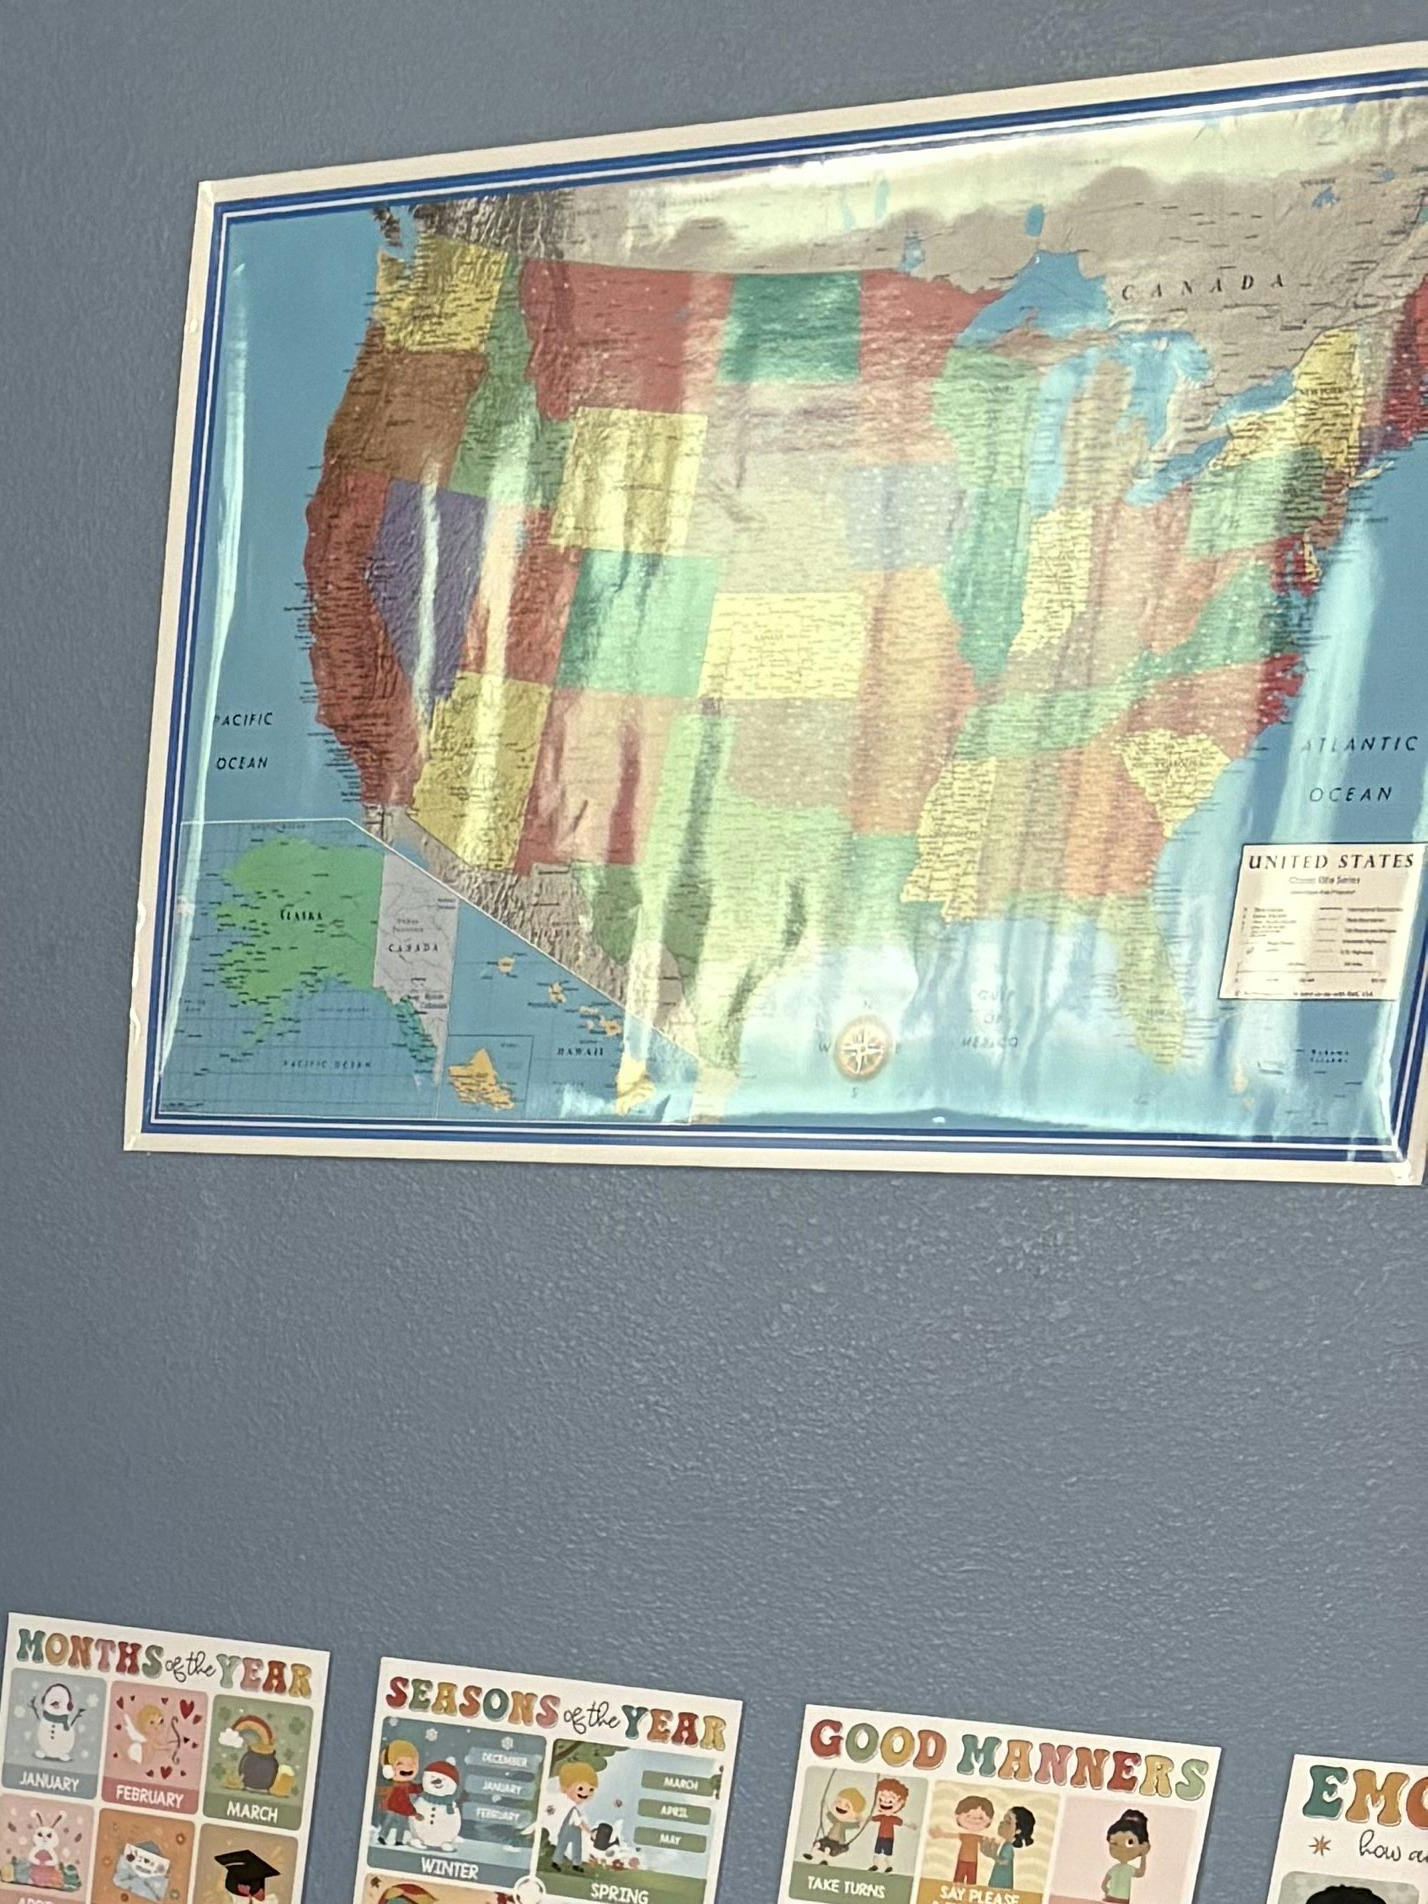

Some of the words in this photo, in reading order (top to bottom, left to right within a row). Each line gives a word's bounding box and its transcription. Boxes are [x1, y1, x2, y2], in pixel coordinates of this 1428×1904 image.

[1121, 274, 1286, 300] CANADA
[216, 757, 269, 770] OCEAN
[1310, 787, 1392, 801] OCEAN
[1249, 854, 1328, 870] UNITED
[1339, 854, 1414, 869] STATES
[16, 1628, 164, 1679] MONTHS
[165, 1658, 187, 1683] of
[186, 1651, 217, 1677] the
[216, 1653, 312, 1699] YEAR
[385, 1676, 560, 1729] SEASONS
[564, 1712, 587, 1734] of
[585, 1701, 622, 1730] the
[622, 1704, 727, 1751] YEAR
[810, 1718, 947, 1771] GOOD
[956, 1733, 1210, 1801] MANNERS
[18, 1771, 80, 1793] JANUARY
[116, 1784, 184, 1809] FEBRUARY
[227, 1800, 277, 1823] MARCH
[1359, 1829, 1402, 1862] how
[421, 1858, 479, 1881] WINTER
[807, 1876, 841, 1893] TAKE
[844, 1880, 886, 1899] TURNS
[939, 1885, 967, 1901] SAY
